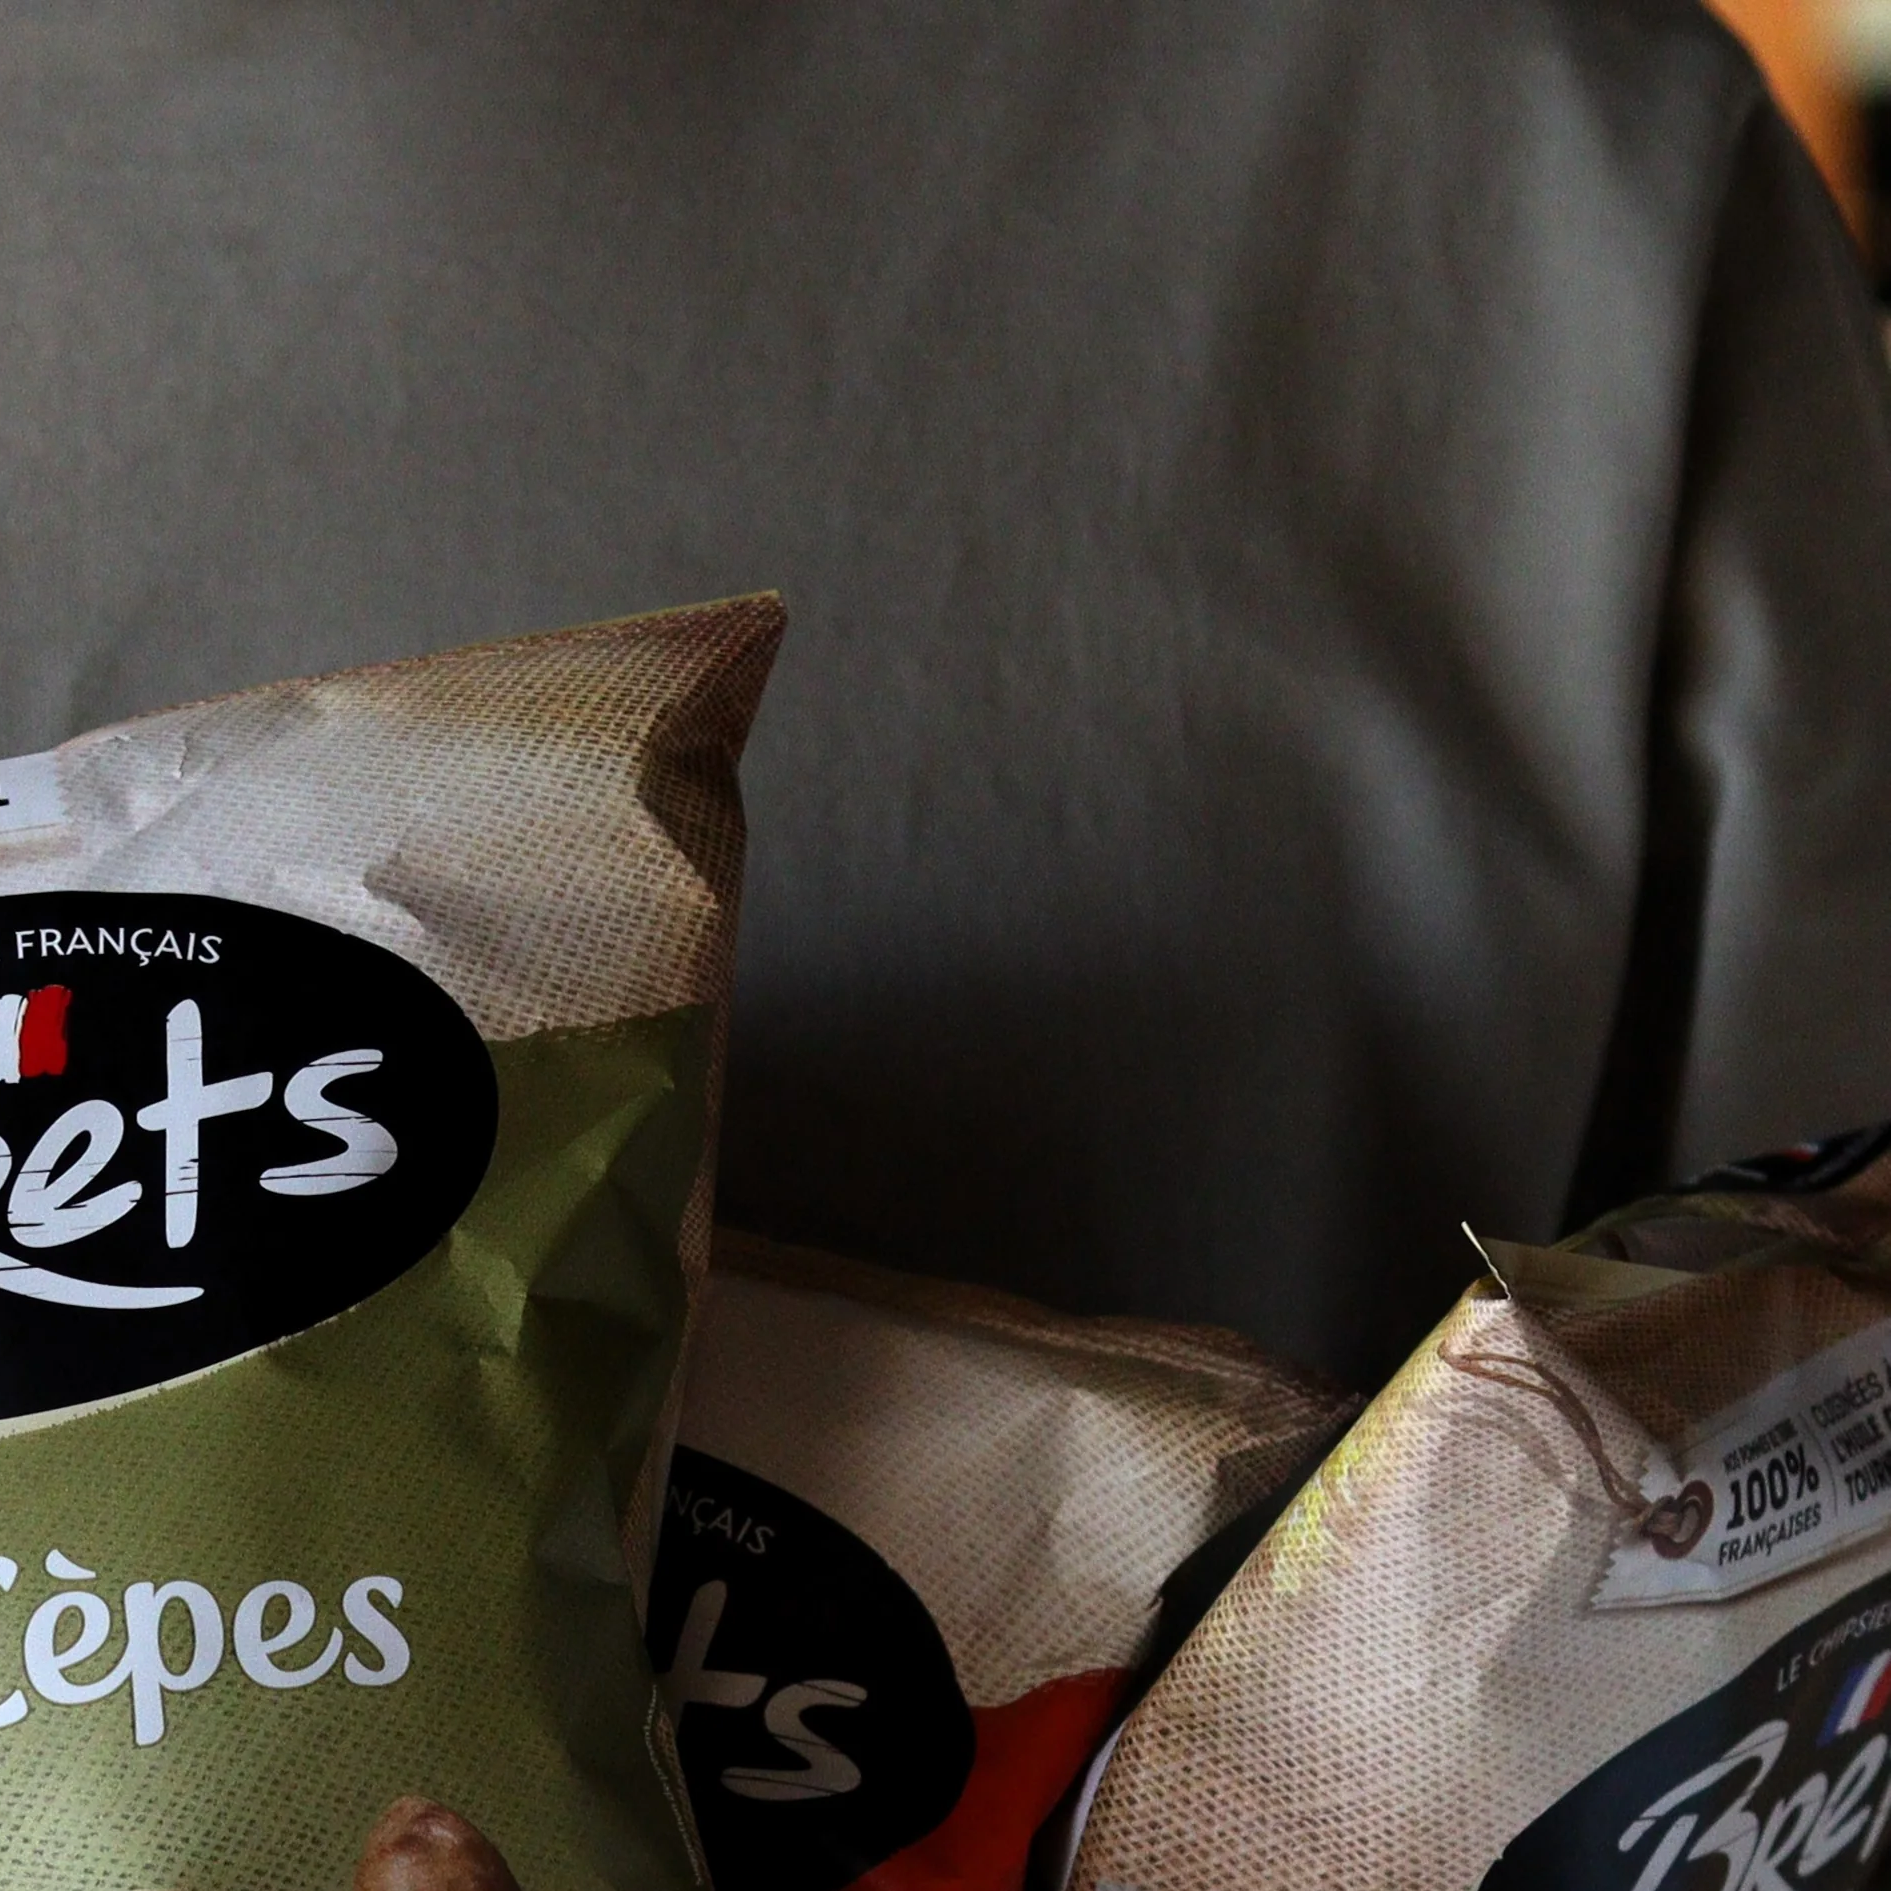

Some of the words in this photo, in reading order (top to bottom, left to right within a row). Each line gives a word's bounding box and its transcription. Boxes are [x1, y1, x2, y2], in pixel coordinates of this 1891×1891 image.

[14, 926, 224, 967] FRANÇAIS
[1726, 1442, 1821, 1532] 100%
[1717, 1501, 1823, 1568] FRANÇAISES
[1776, 1653, 1804, 1693] LE
